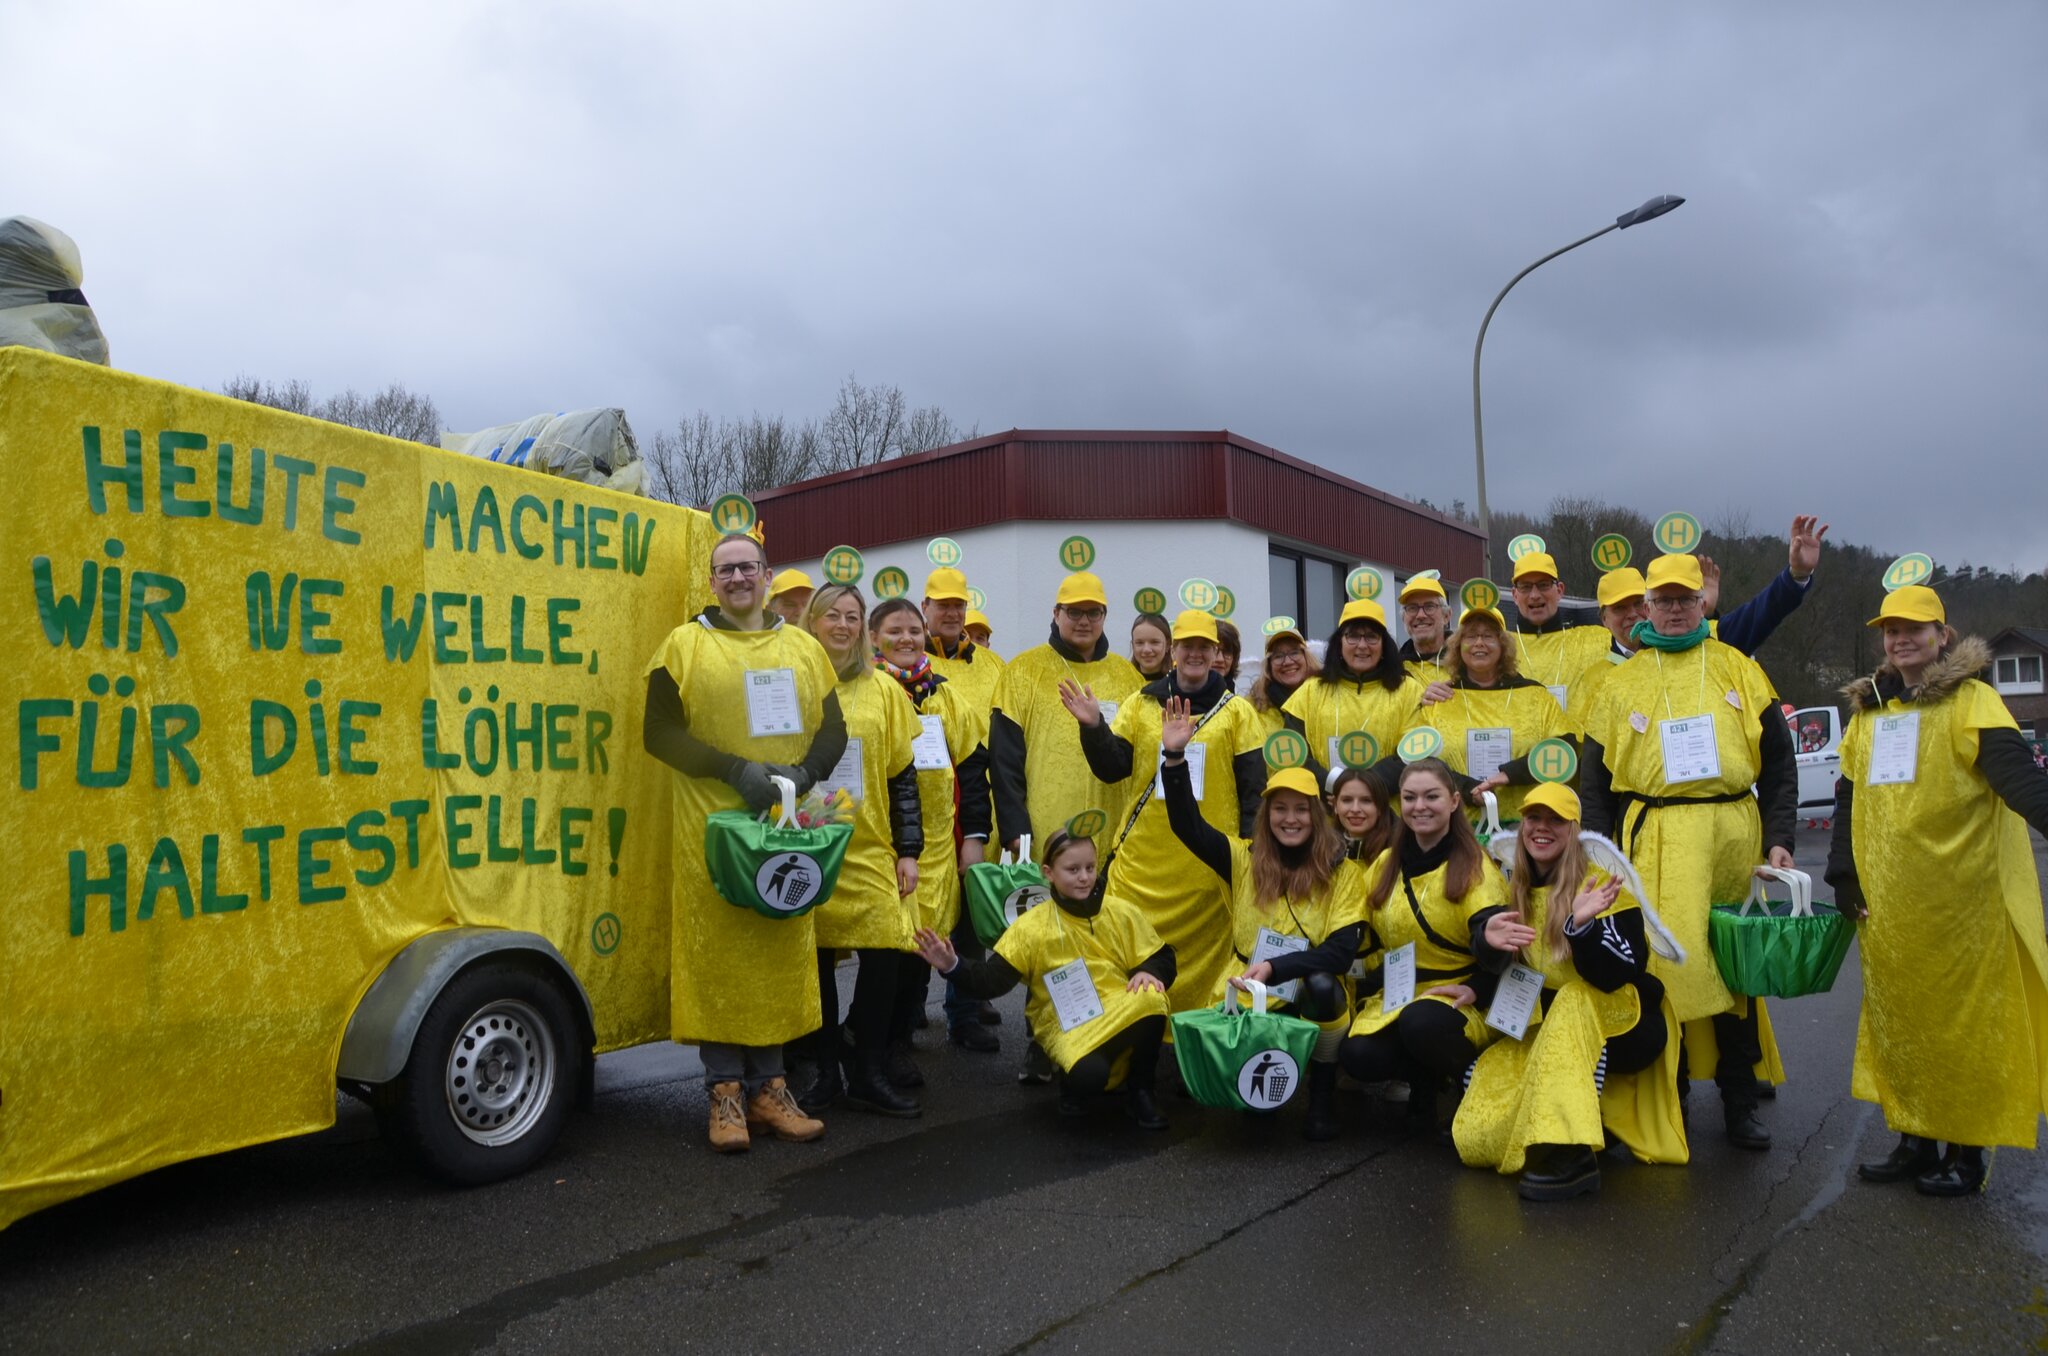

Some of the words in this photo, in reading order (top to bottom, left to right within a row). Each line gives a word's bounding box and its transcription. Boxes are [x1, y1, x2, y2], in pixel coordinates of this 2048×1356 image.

[83, 426, 366, 546] HEUTE
[424, 481, 656, 576] MACHEN
[245, 570, 346, 655] NE
[380, 584, 599, 676] WELLE,
[18, 673, 201, 790] FÜR
[421, 684, 613, 776] LÖHER
[68, 793, 627, 937] HALTESTELLE!
